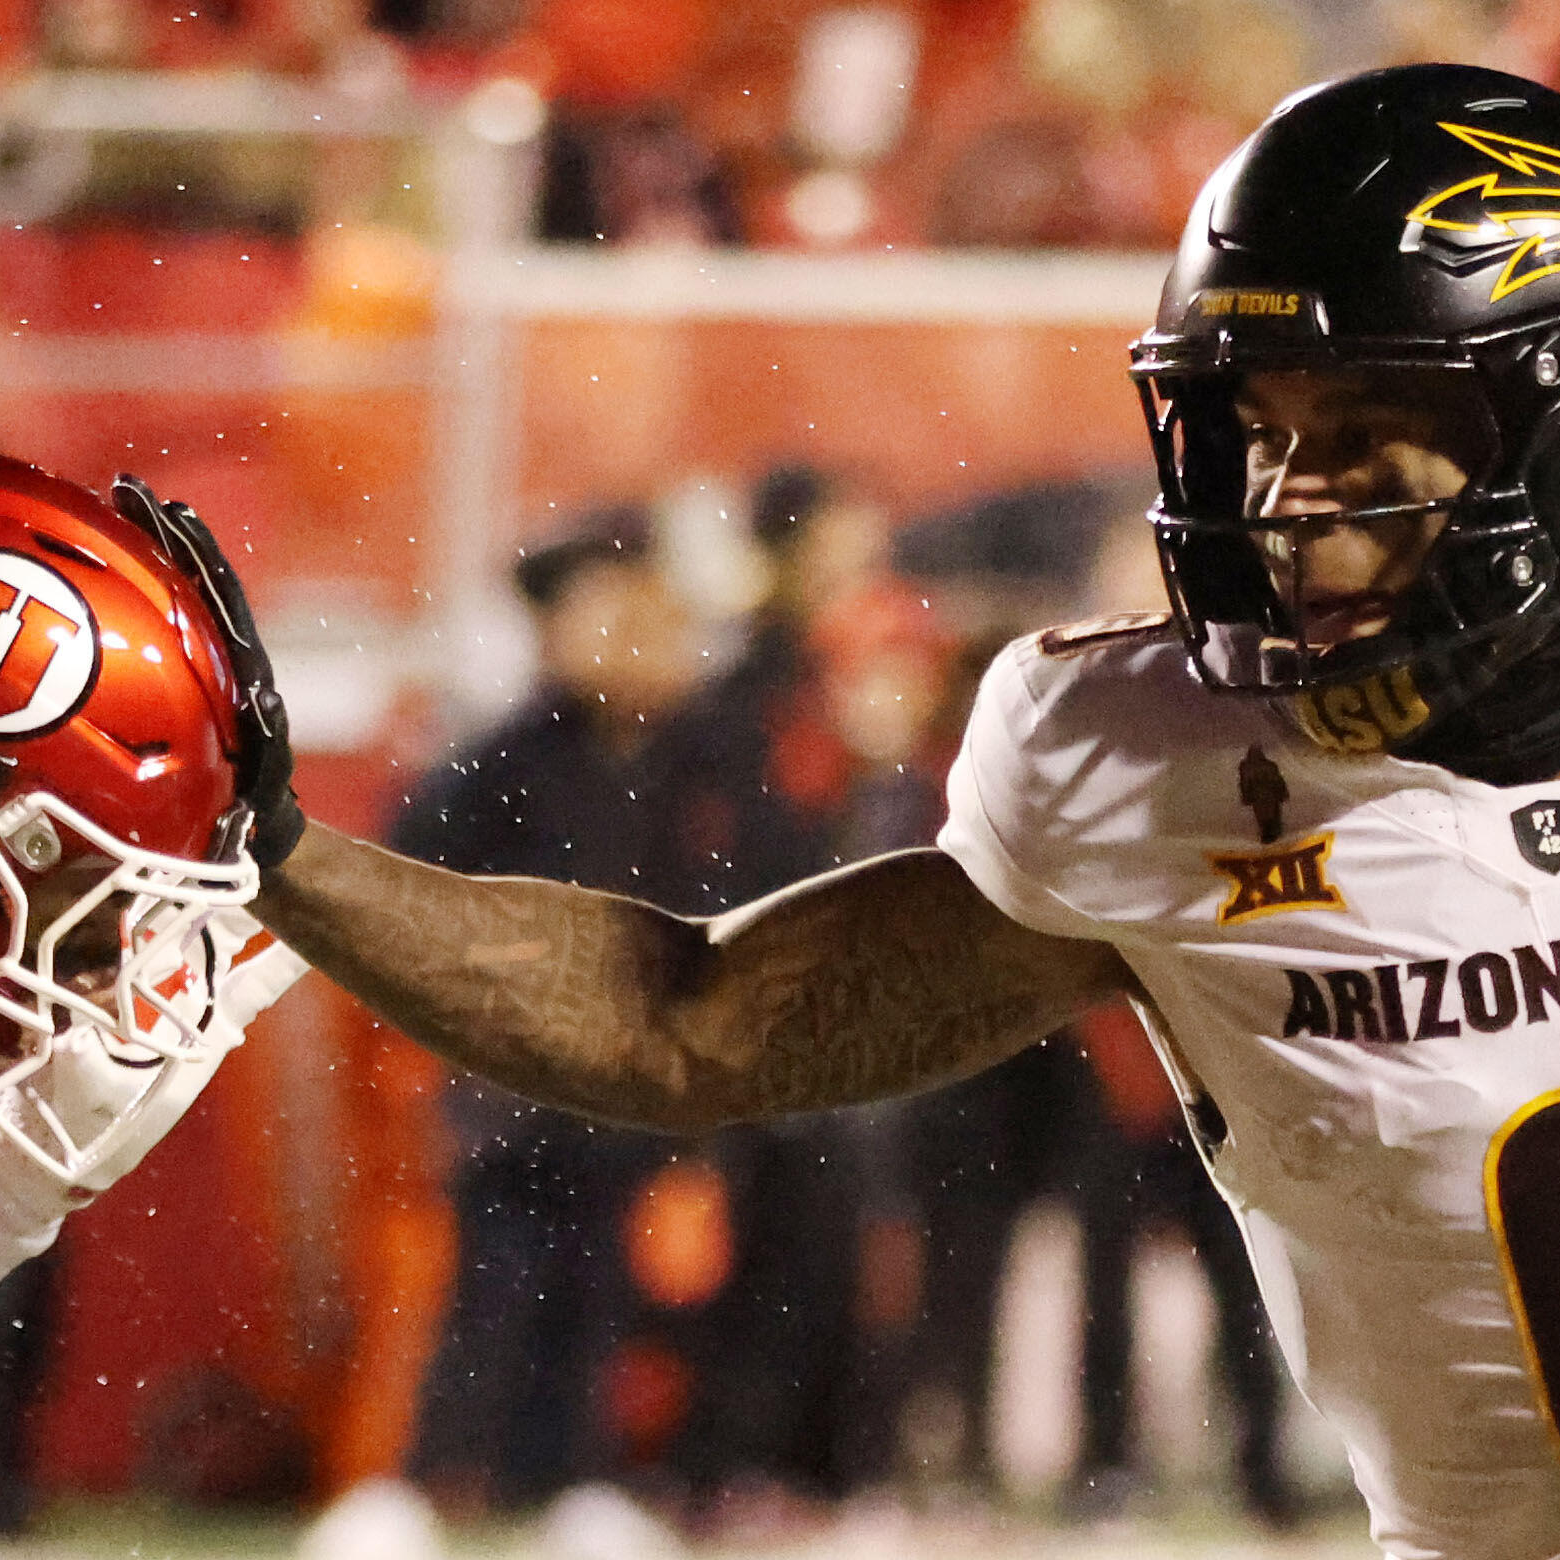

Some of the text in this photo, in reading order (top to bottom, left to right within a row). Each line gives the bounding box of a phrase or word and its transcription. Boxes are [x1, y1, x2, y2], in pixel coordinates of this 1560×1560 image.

[1238, 293, 1299, 316] DEVILS
[1532, 808, 1557, 830] PT
[1211, 838, 1338, 922] XII
